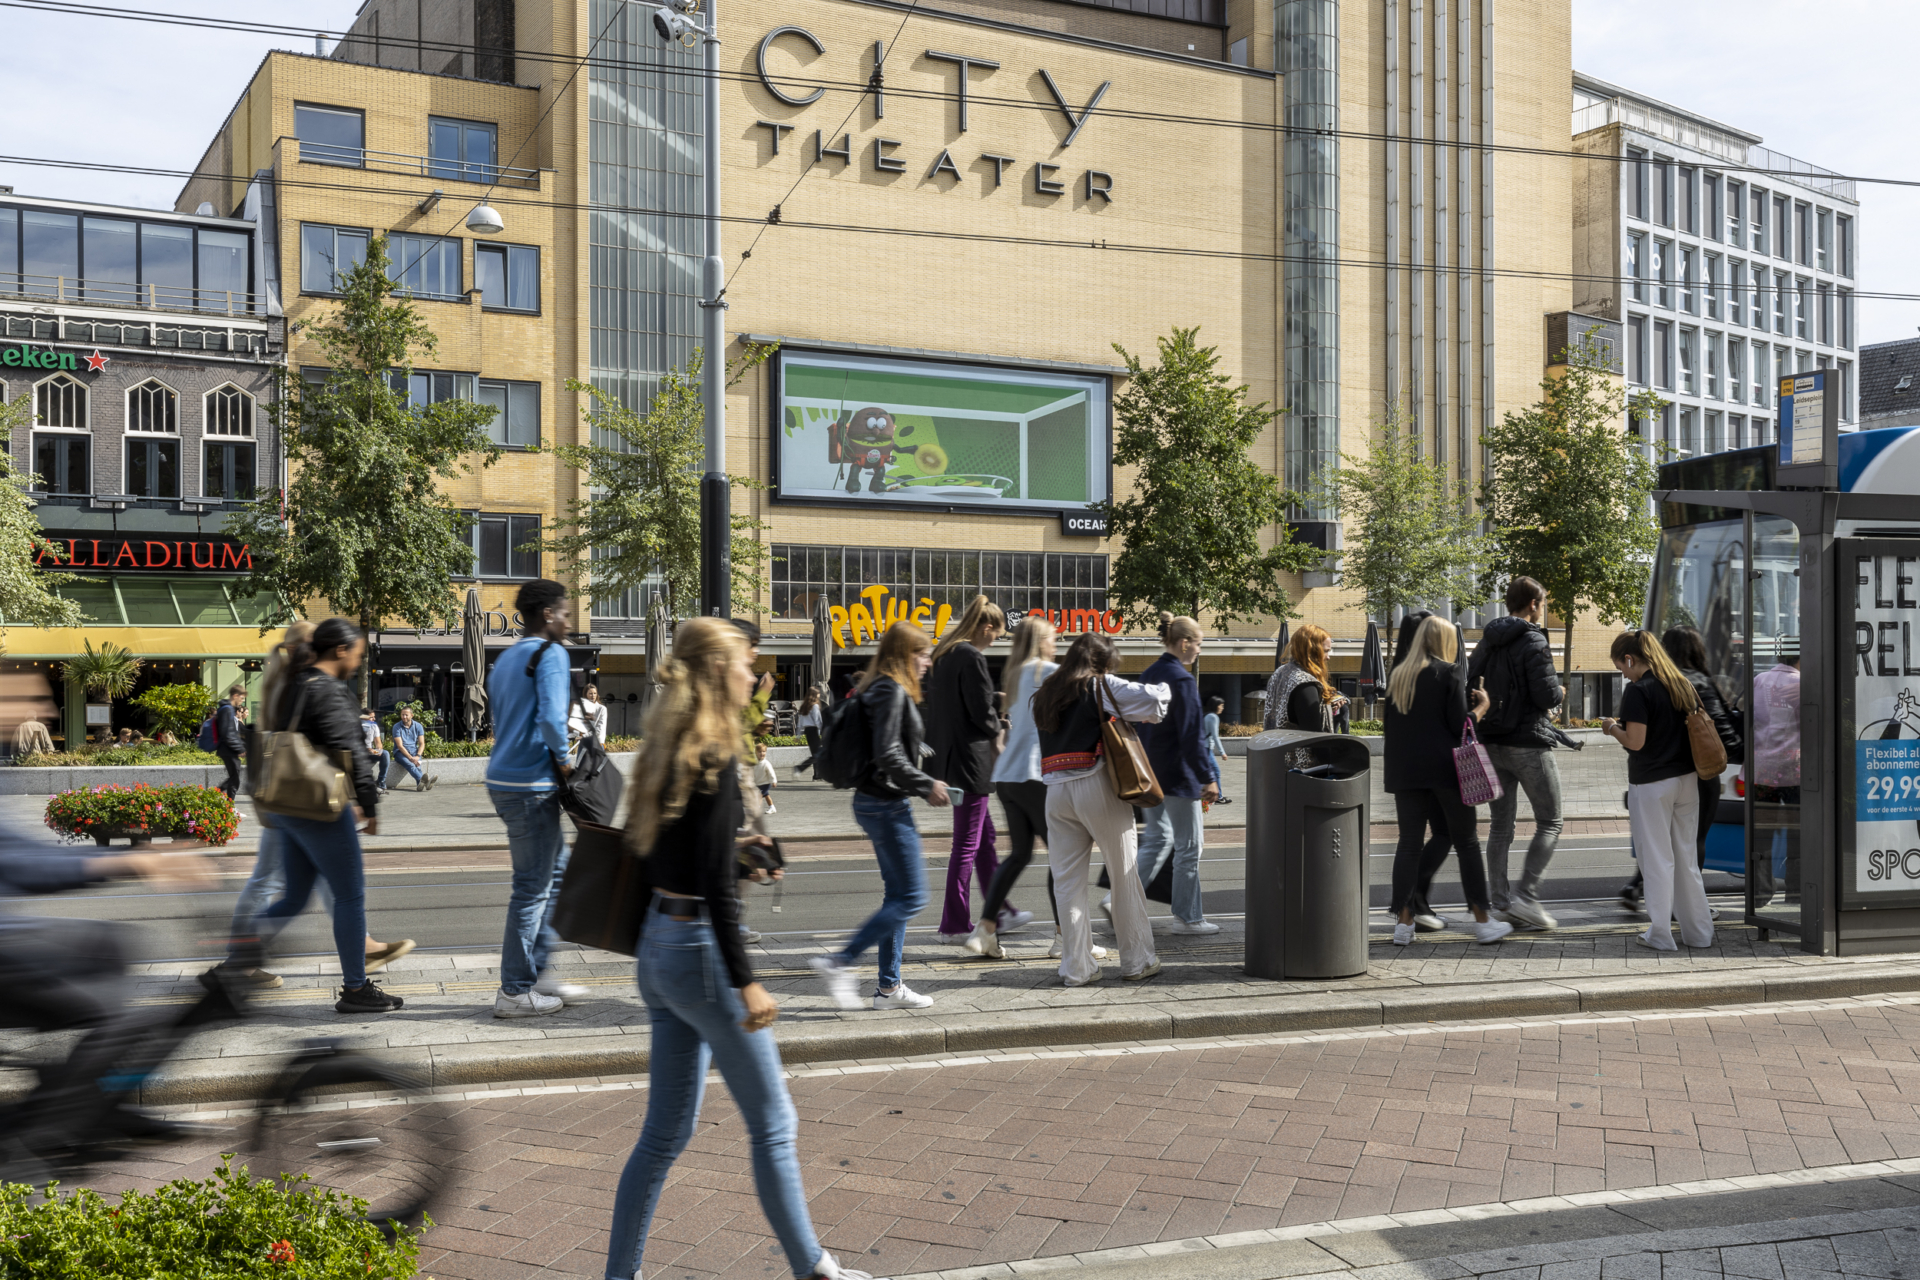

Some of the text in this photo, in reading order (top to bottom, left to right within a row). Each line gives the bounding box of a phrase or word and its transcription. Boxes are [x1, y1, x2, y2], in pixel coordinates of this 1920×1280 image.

[757, 25, 1111, 148] CITY
[757, 120, 1113, 203] THEATER
[0, 344, 78, 370] eken
[1793, 394, 1823, 404] Leidseplein
[30, 538, 253, 569] ALLADIUM
[1855, 556, 1920, 609] FLE
[1865, 747, 1908, 759] Flexibel
